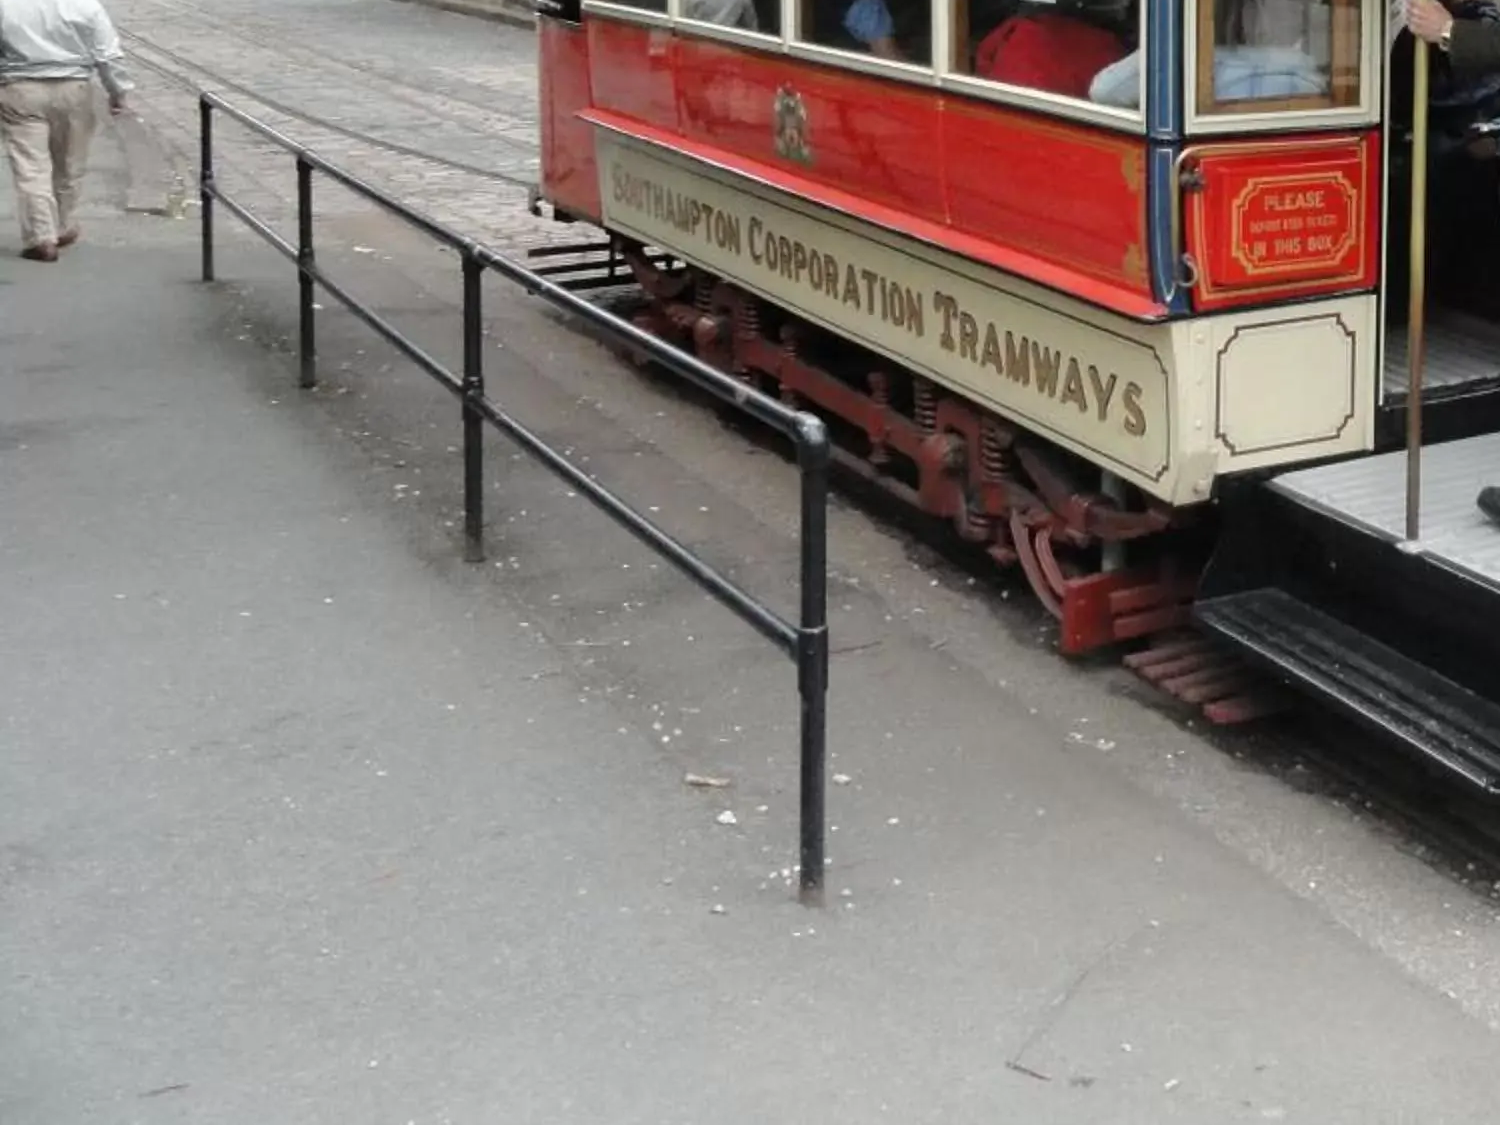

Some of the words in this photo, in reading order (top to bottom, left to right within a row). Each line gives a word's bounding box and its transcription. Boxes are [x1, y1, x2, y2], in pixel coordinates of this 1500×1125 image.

[1264, 190, 1325, 212] PLEASE
[1274, 236, 1301, 254] THIS
[1307, 234, 1333, 252] BOX
[612, 161, 741, 255] SOUTHAMPTON
[748, 216, 934, 338] CORPORATION
[933, 290, 1147, 437] TRAMWAYS
